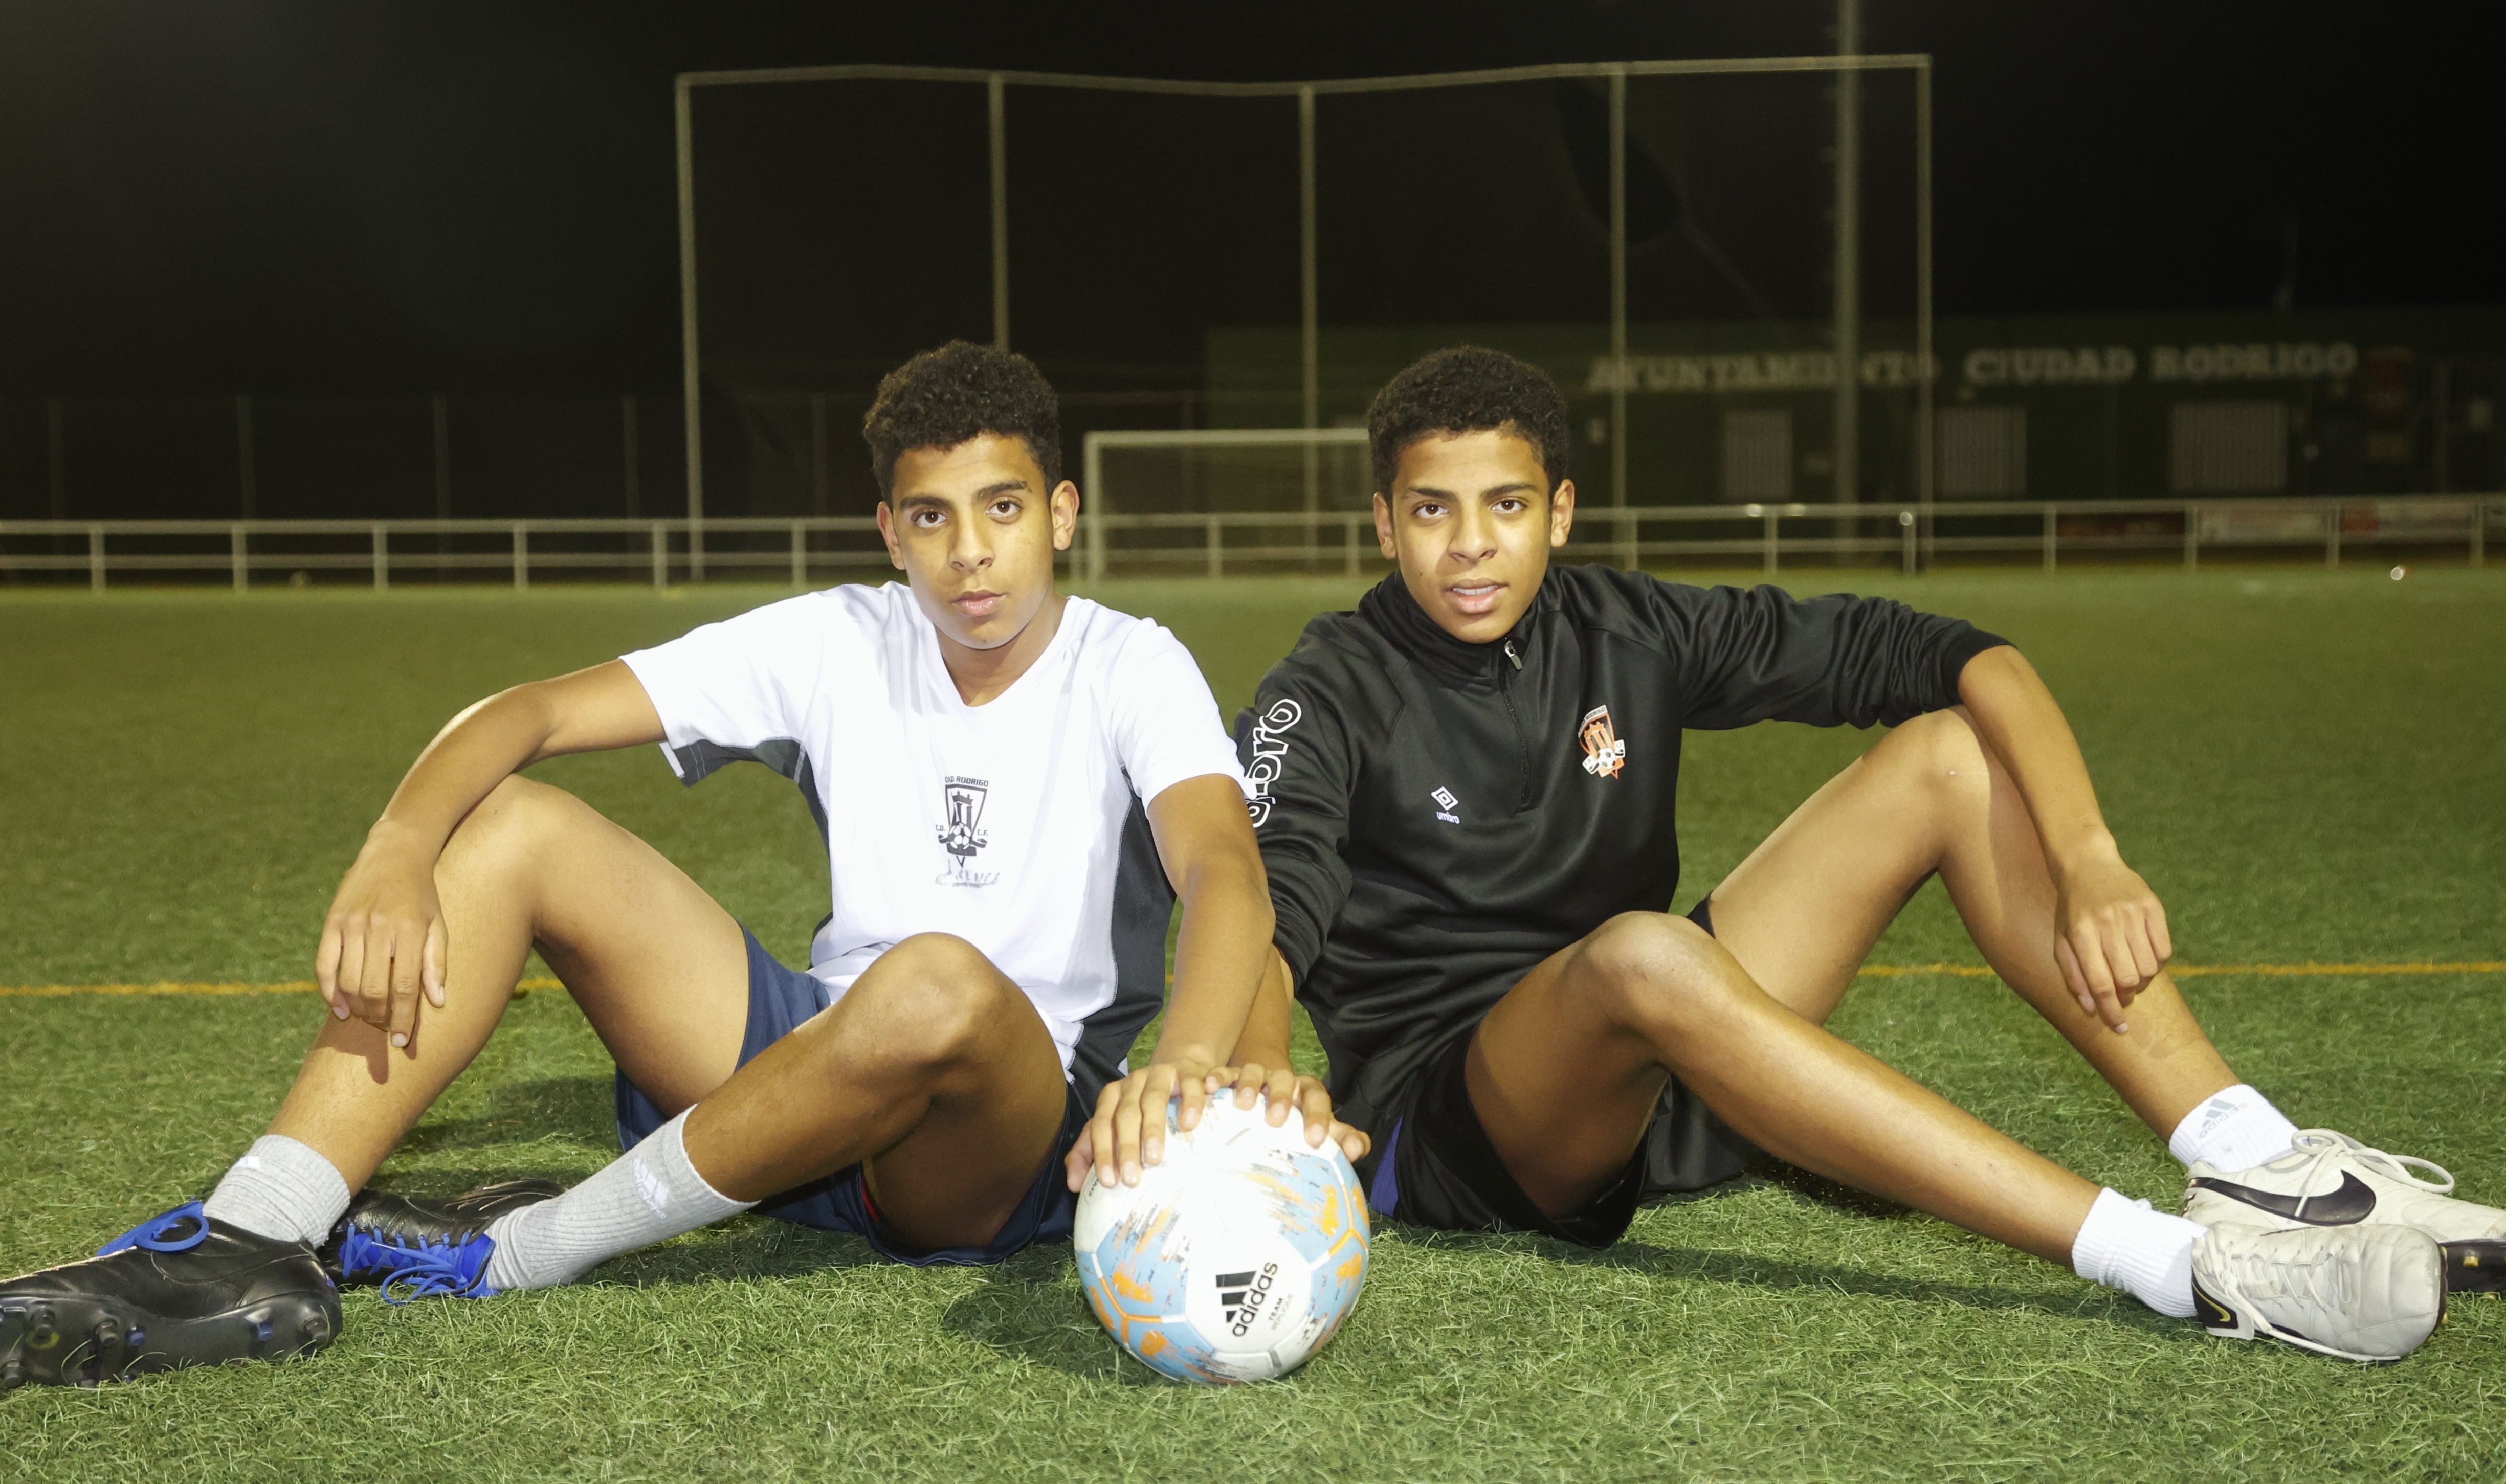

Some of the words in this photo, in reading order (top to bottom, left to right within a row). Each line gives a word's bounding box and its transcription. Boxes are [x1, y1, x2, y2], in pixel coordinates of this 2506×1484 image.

[1964, 347, 2136, 385] CIUDAD
[2152, 342, 2358, 381] RODRIGO
[956, 775, 989, 788] RODRIGO
[1436, 811, 1460, 824] umbro
[2199, 1102, 2247, 1138] adidas
[1232, 1262, 1278, 1337] adidas
[1268, 1298, 1284, 1321] TEAM
